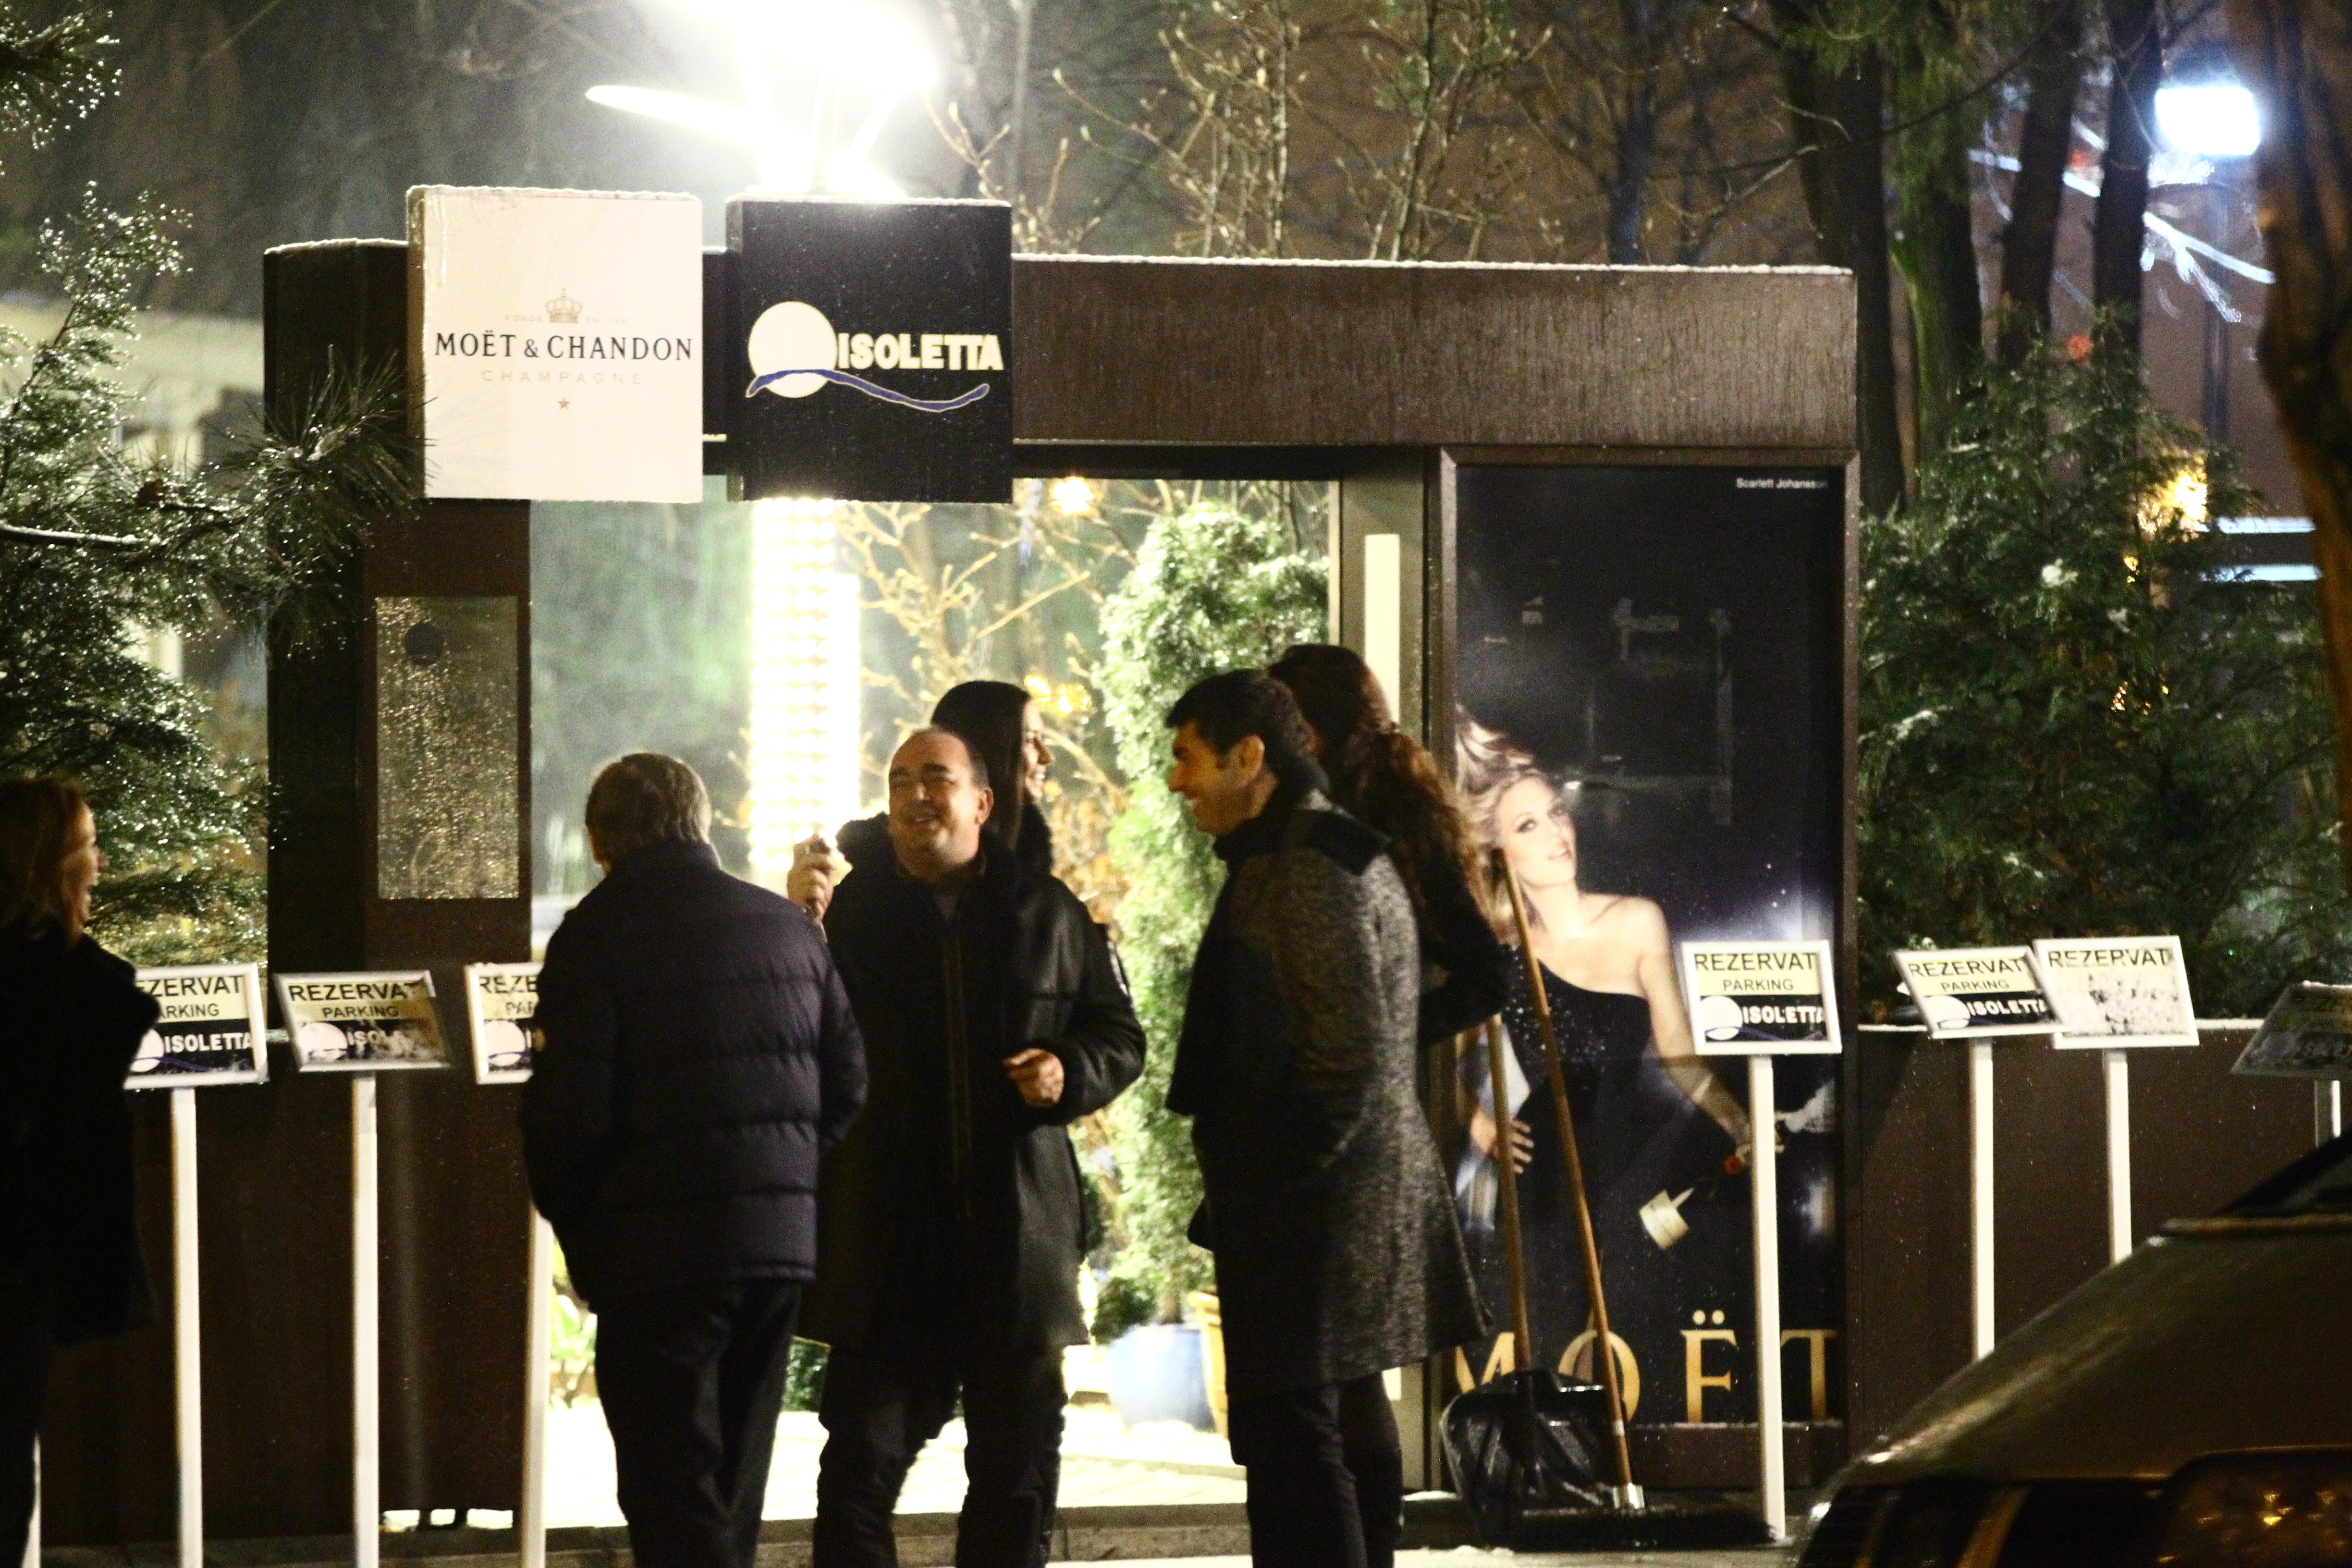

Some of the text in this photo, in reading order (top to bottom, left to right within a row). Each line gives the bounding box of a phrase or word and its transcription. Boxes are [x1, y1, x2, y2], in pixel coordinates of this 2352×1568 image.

[435, 330, 692, 361] MOËT & CHANDON
[838, 333, 1004, 371] ISOLETTA
[482, 370, 642, 385] CHAMPAGNE
[1694, 952, 1819, 971] REZERVAT
[1908, 958, 2024, 977] REZERVAT
[1723, 979, 1794, 991] PARKING
[1941, 980, 2010, 992] PARKING
[322, 1005, 399, 1022] PARKING
[1454, 1309, 1837, 1423] MOËT
